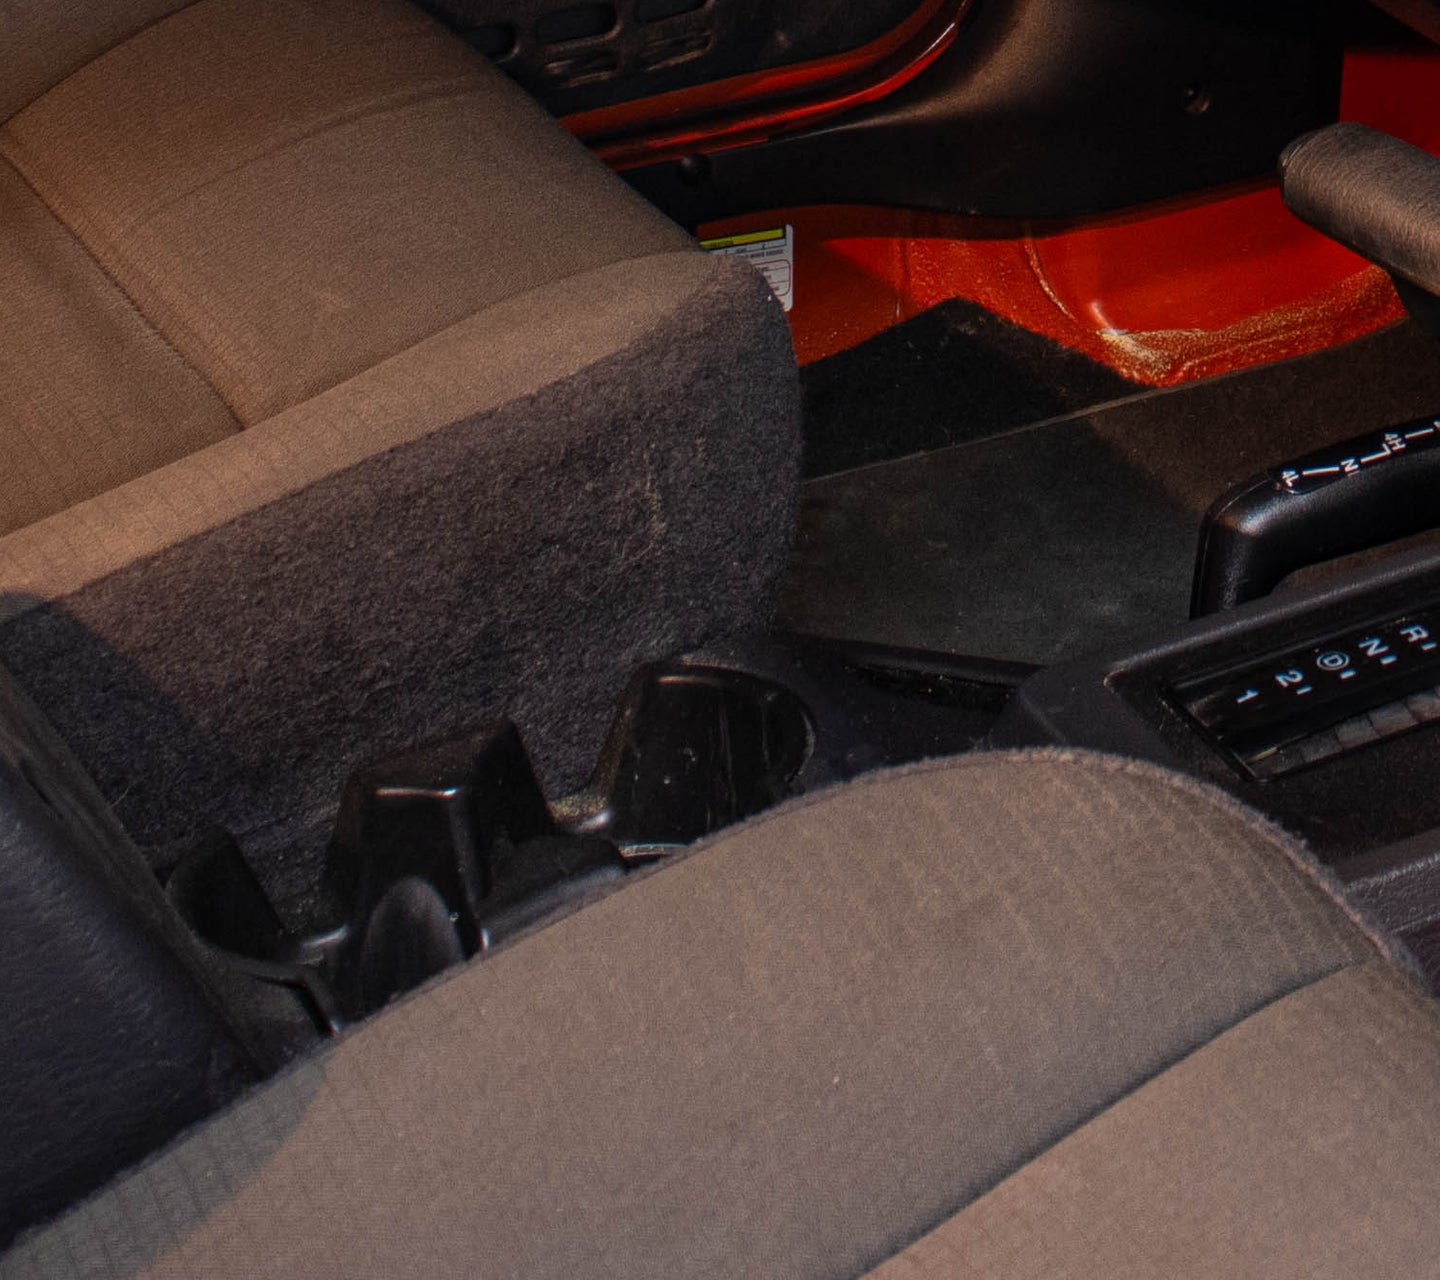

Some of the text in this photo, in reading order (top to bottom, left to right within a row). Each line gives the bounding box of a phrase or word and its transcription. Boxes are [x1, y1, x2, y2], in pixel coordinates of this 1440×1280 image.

[1384, 432, 1406, 452] 4H
[1340, 458, 1359, 474] N
[1281, 468, 1300, 488] 4L
[1400, 625, 1430, 646] R
[1359, 637, 1390, 660] N
[1275, 670, 1304, 688] 2
[1236, 687, 1260, 706] 1
